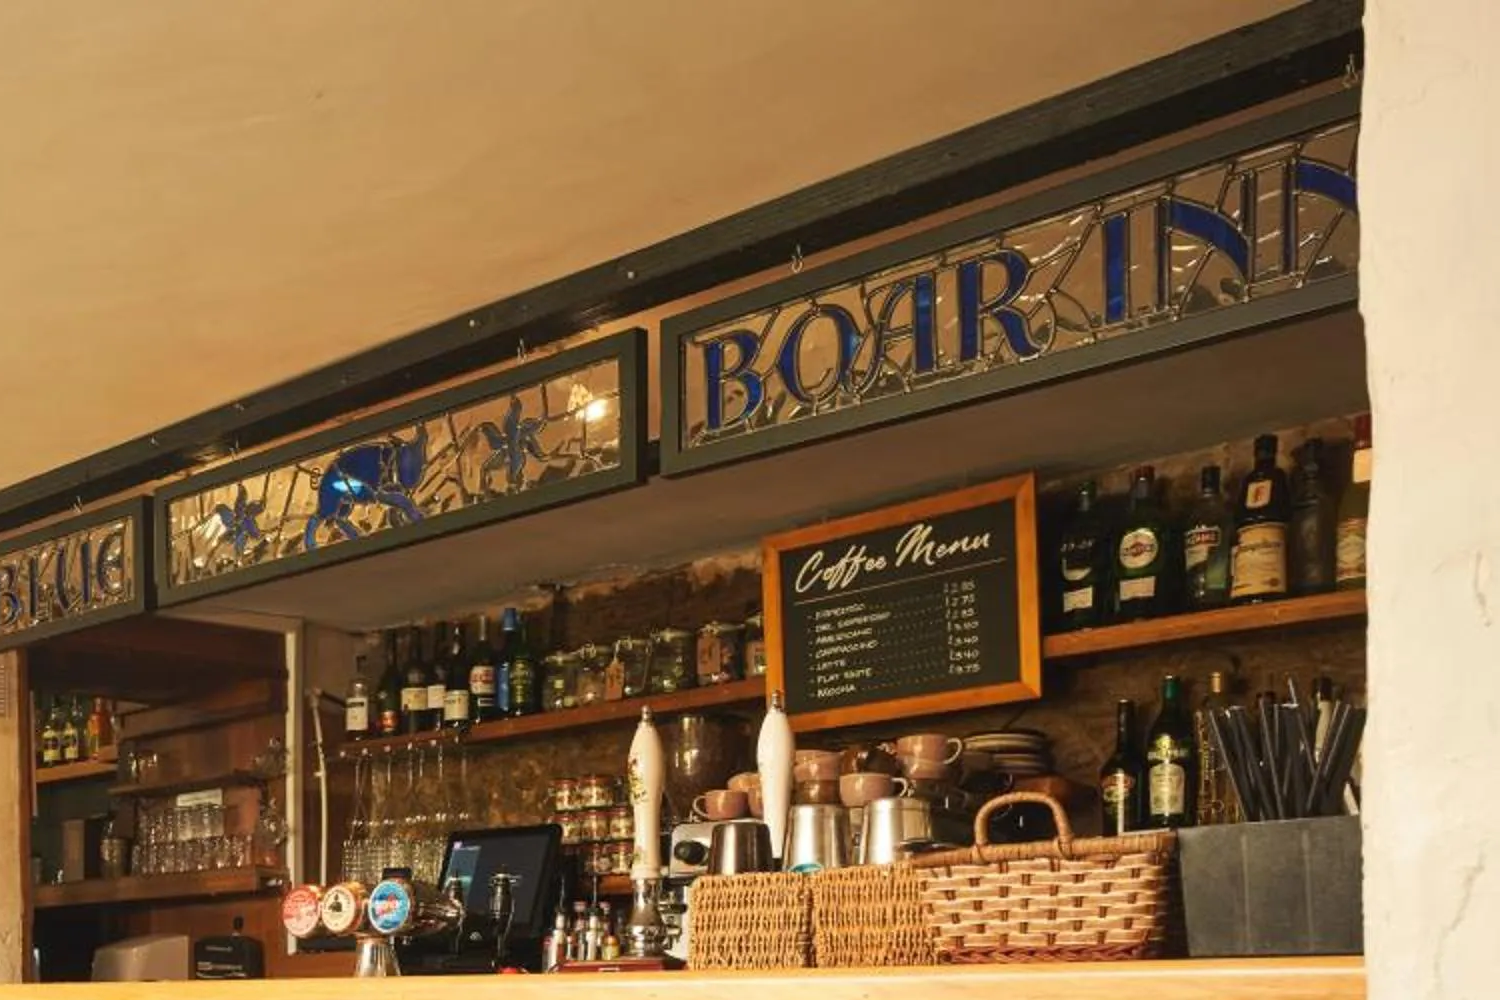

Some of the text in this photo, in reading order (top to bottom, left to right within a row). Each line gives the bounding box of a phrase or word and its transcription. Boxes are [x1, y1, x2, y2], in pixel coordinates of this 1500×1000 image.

[696, 250, 1056, 433] BOAR
[795, 523, 990, 593] Coffee Menu
